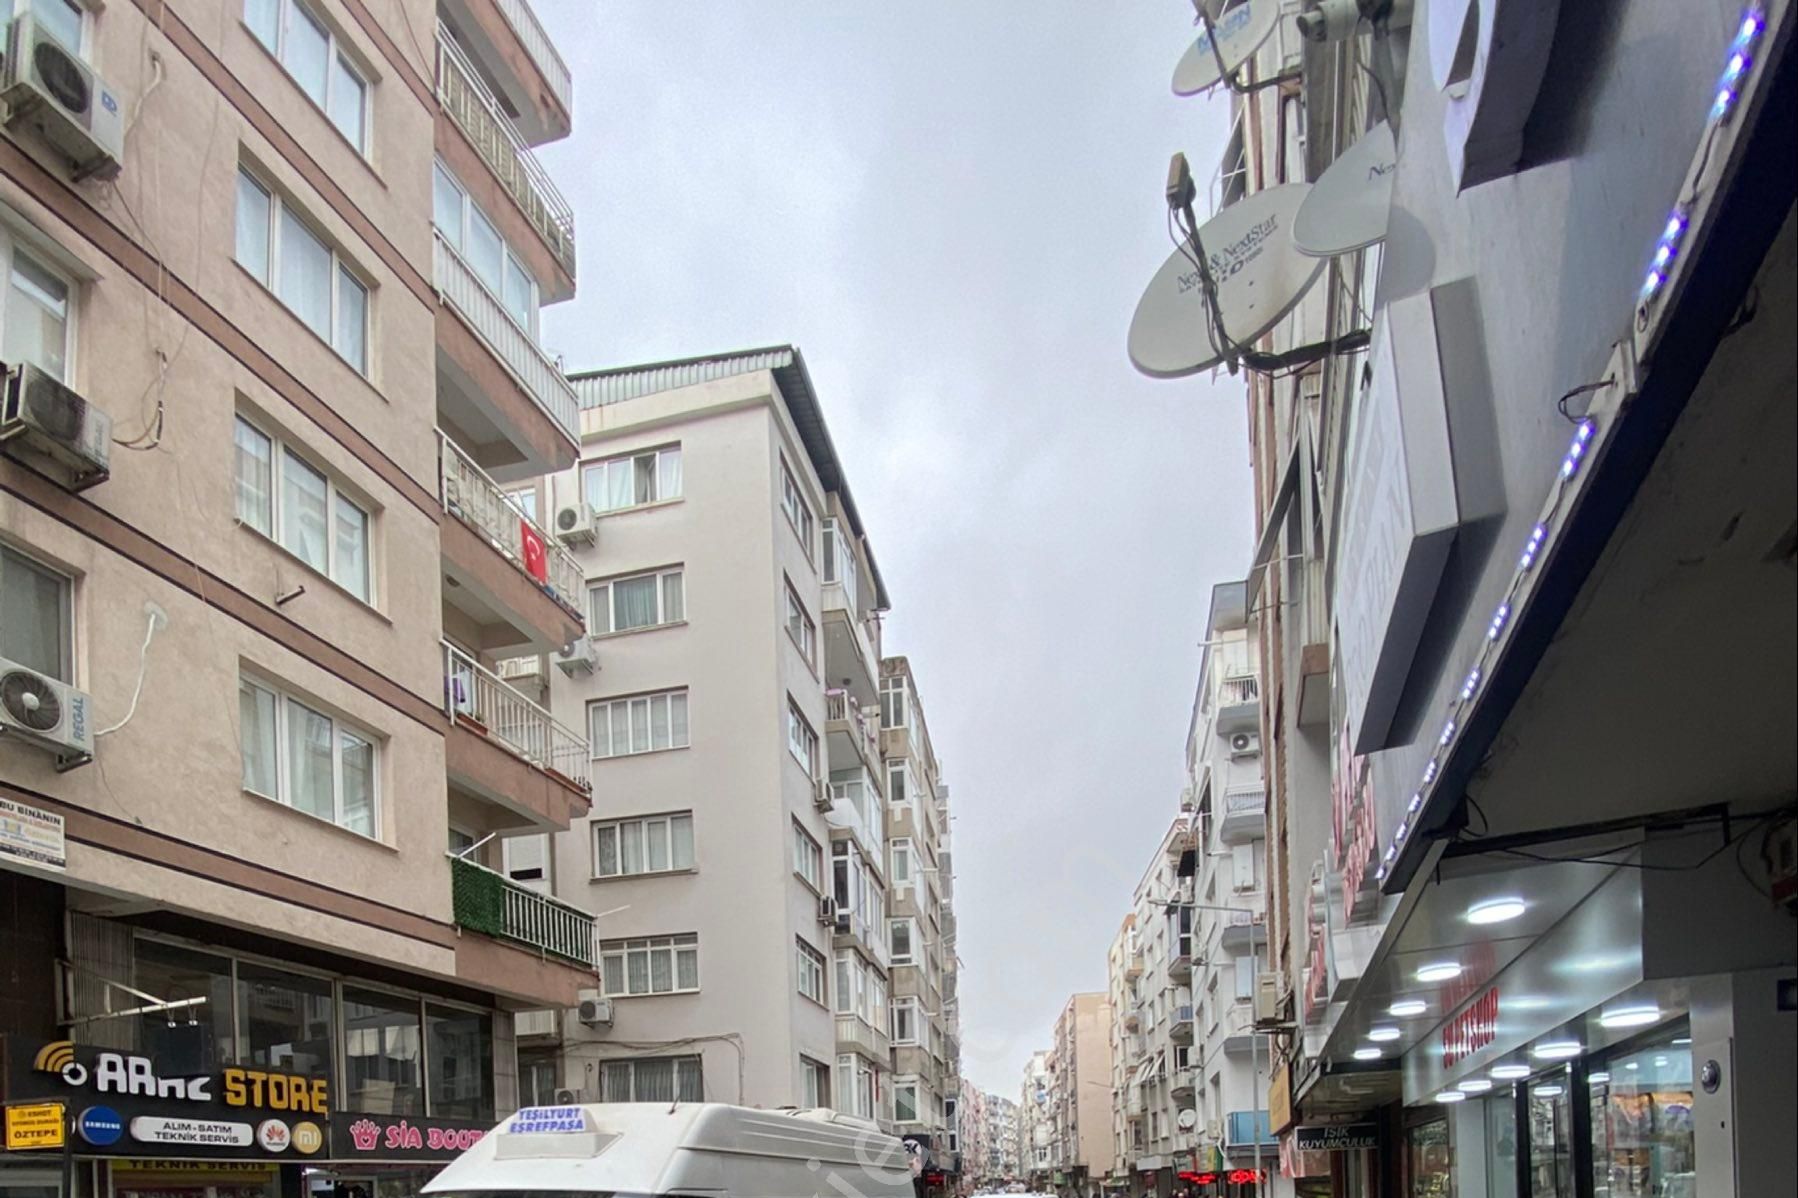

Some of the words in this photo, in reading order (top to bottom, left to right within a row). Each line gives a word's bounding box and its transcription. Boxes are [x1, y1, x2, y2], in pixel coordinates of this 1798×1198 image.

[73, 697, 85, 741] REGAL
[223, 1067, 328, 1114] STORE
[85, 1121, 120, 1130] SAMSUNG
[428, 1128, 490, 1150] BOUT
